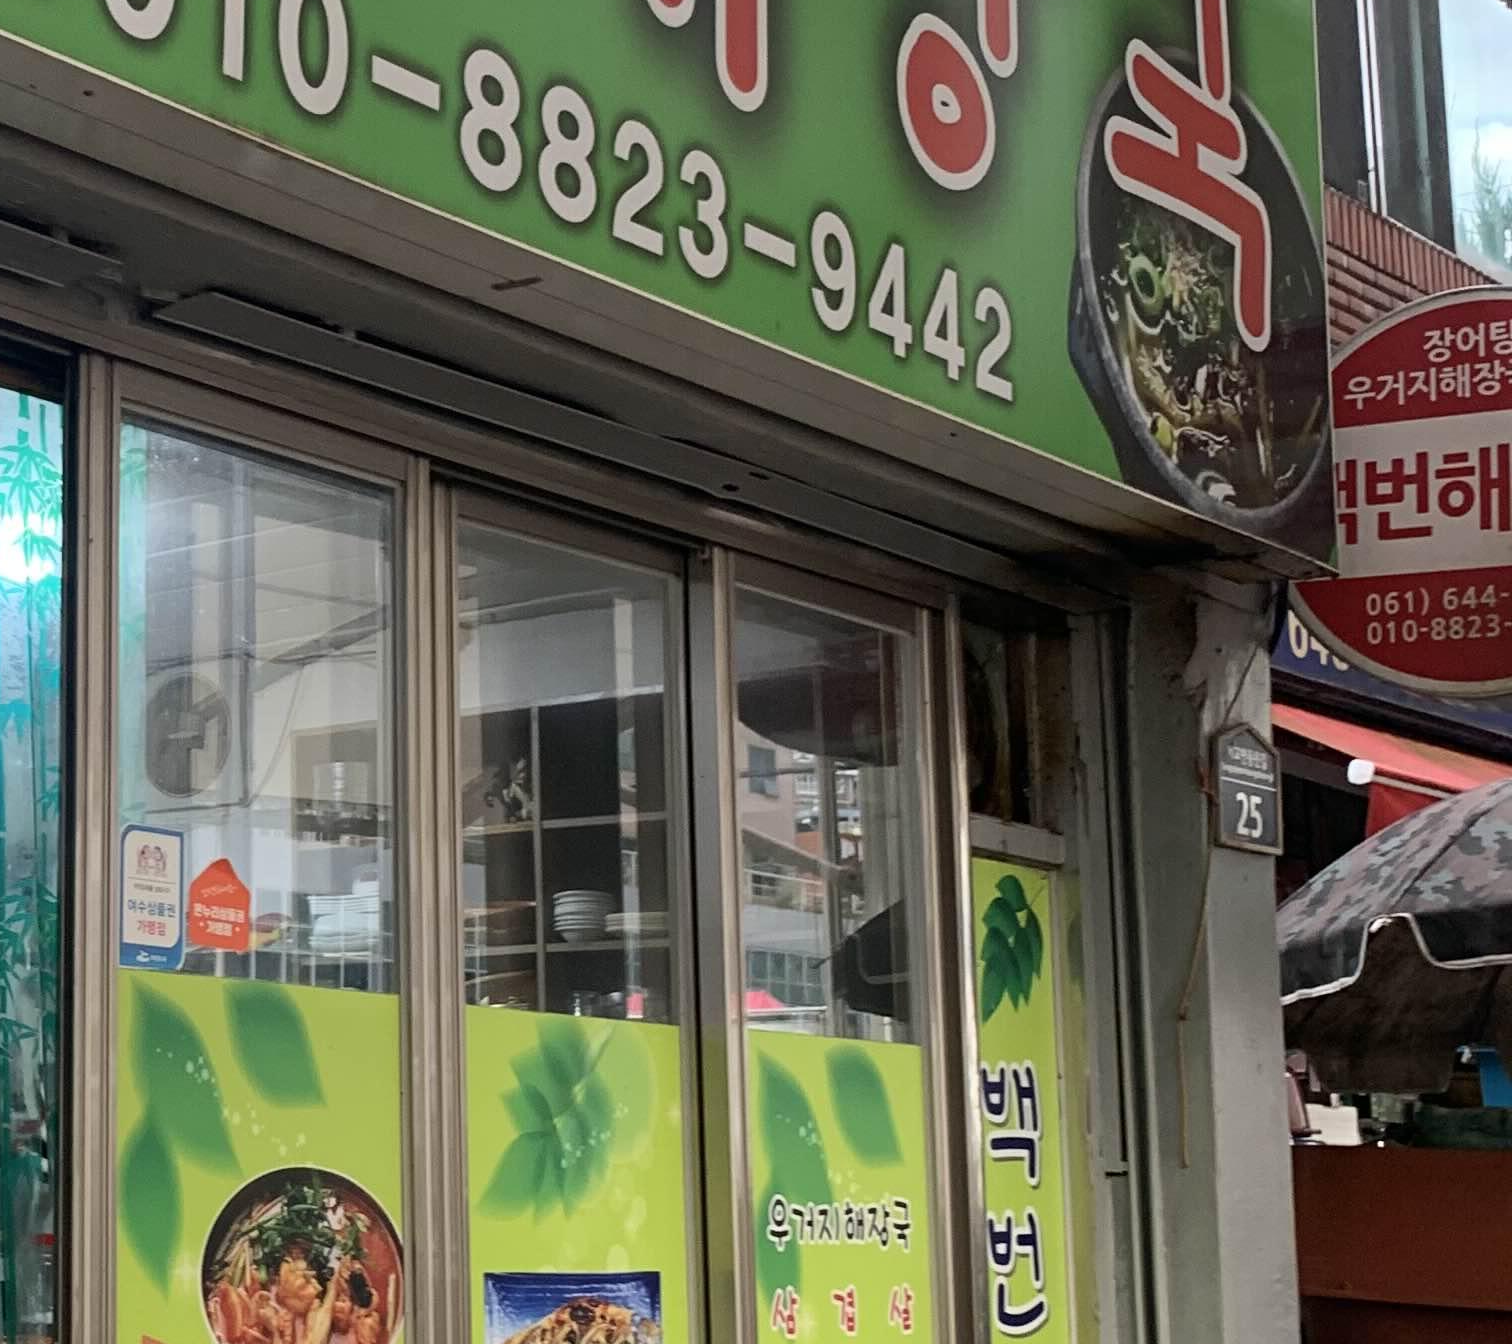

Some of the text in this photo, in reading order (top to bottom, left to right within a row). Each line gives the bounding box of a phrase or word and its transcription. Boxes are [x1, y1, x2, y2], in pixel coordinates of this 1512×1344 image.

[1365, 584, 1512, 616] 061) 644-
[1366, 613, 1512, 645] 010-8823-
[1235, 791, 1263, 838] 25
[127, 899, 176, 918] 여수상품권
[768, 1194, 912, 1253] 우거지해장국
